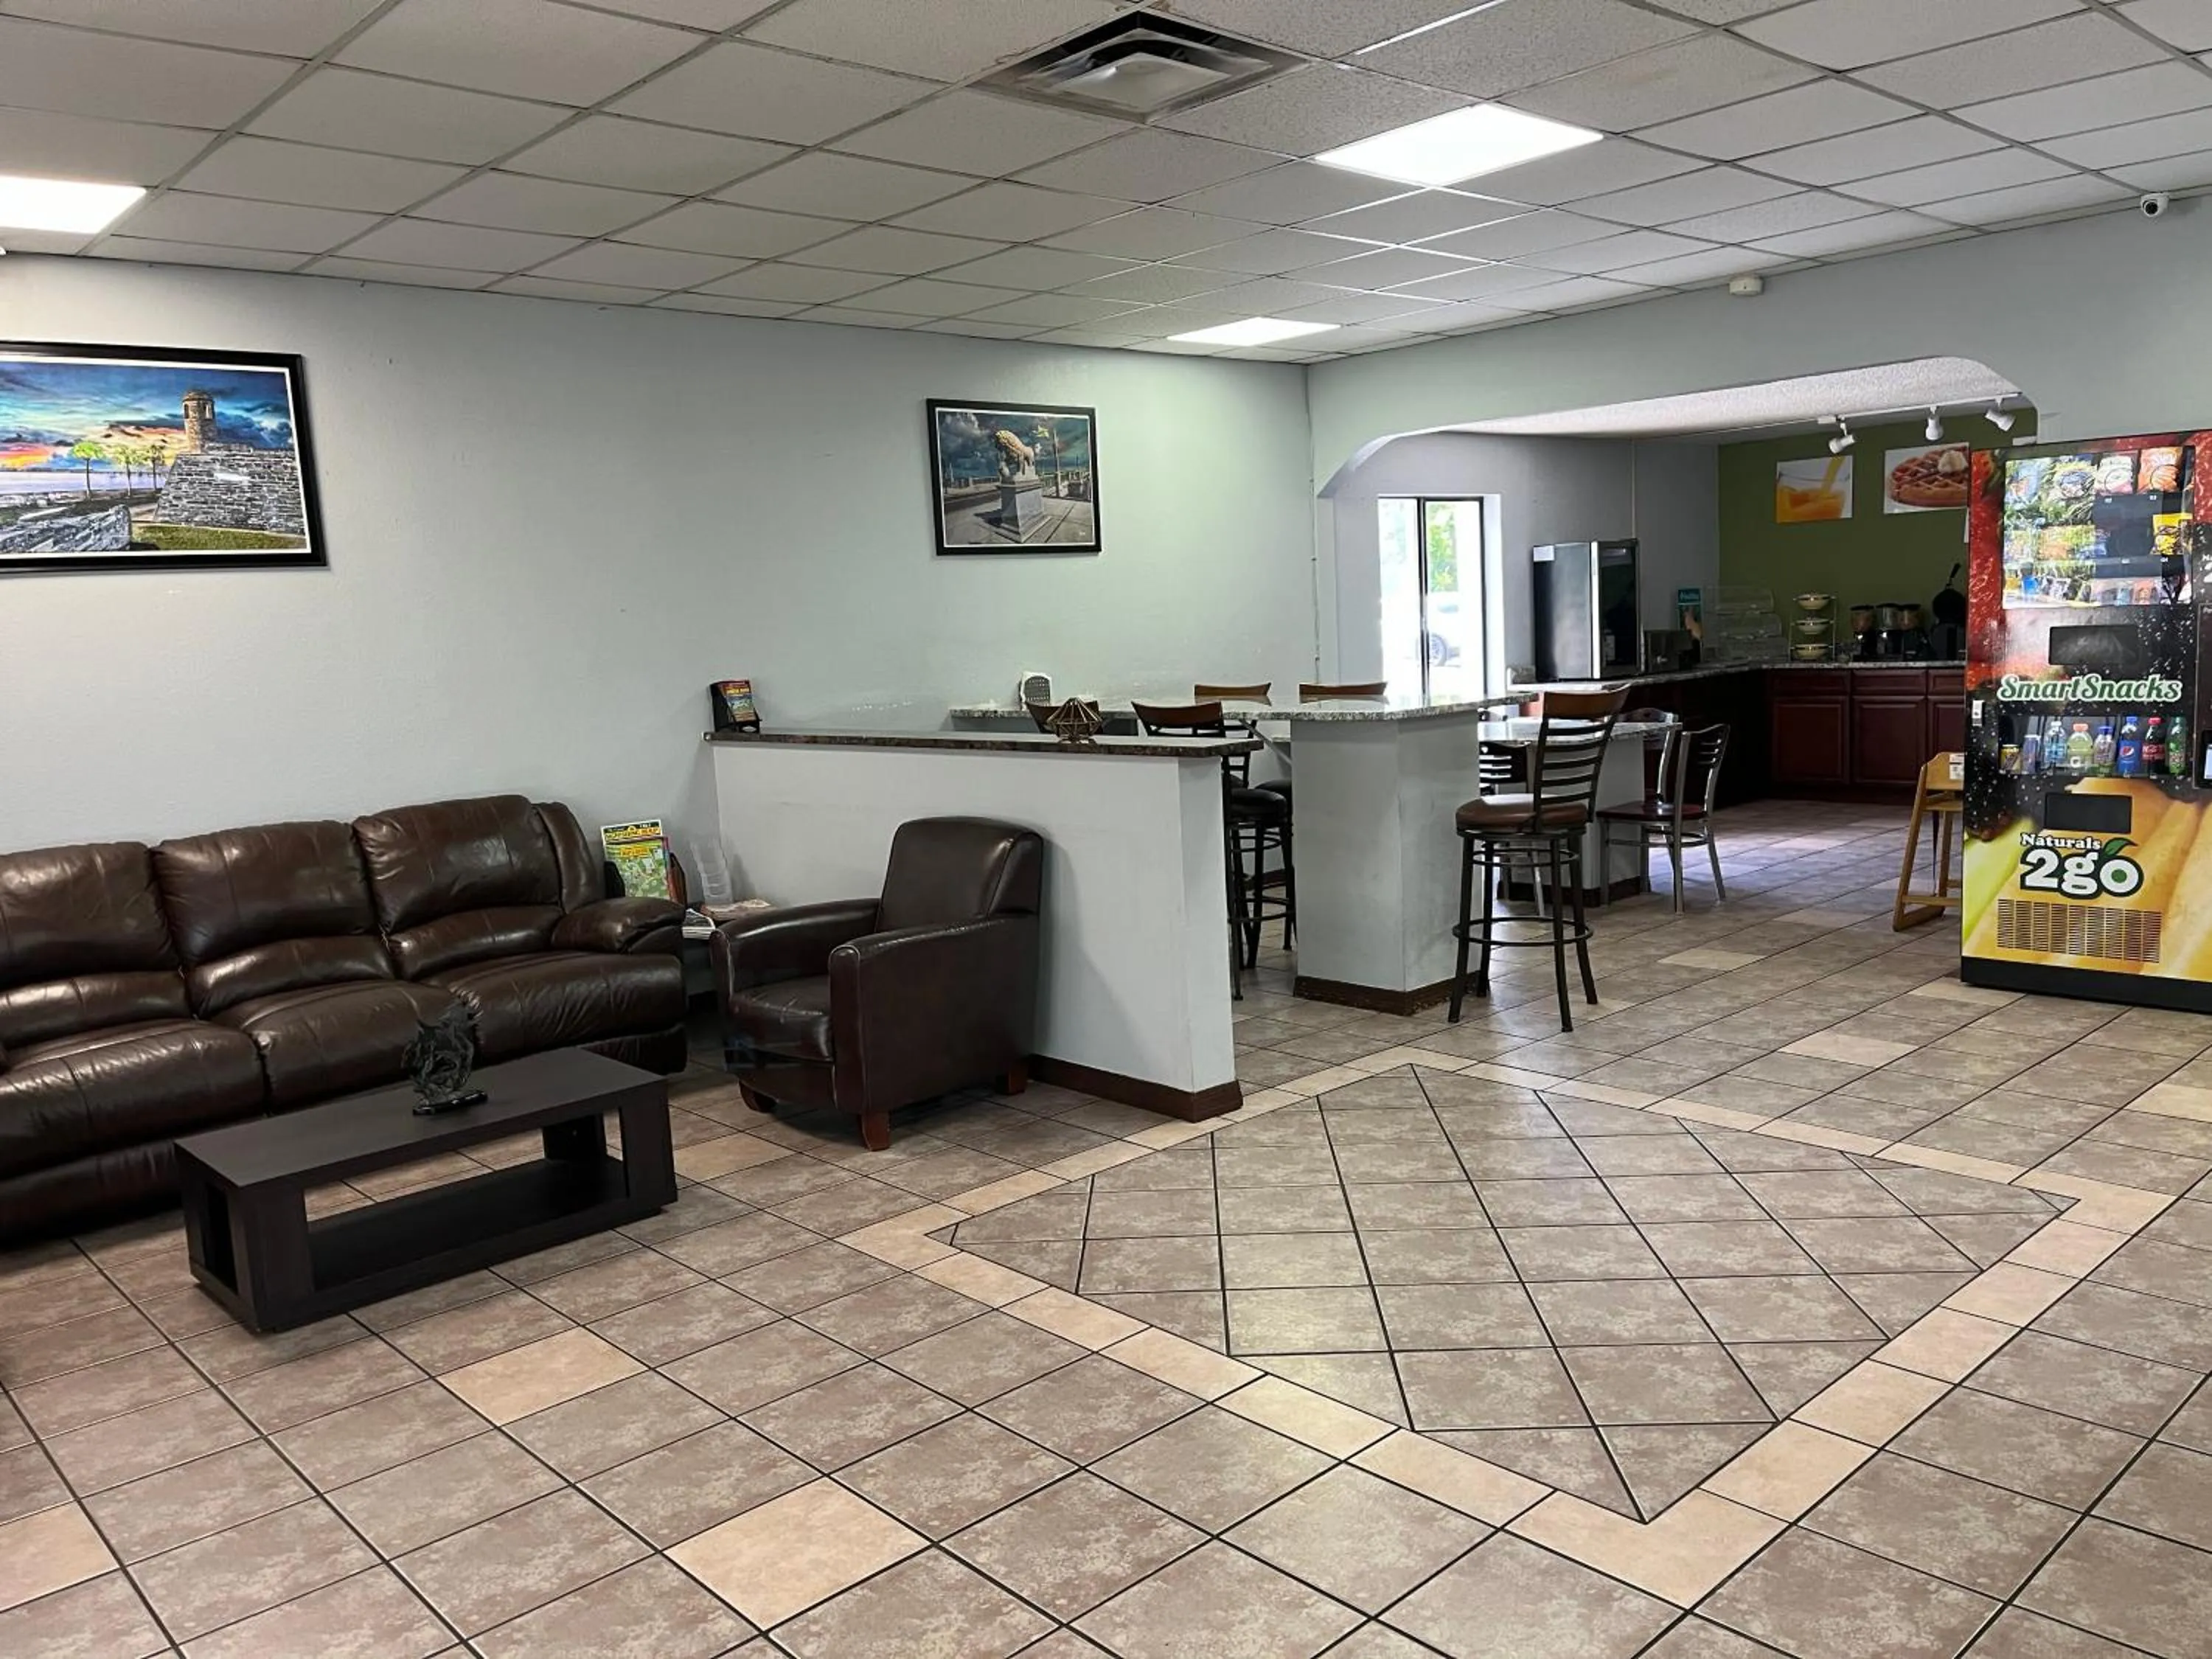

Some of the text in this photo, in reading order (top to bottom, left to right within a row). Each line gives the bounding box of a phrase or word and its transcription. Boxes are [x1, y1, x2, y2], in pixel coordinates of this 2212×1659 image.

[1997, 674, 2183, 701] SmartSnacks
[2021, 833, 2101, 849] Naturals
[2023, 847, 2141, 897] 2go
